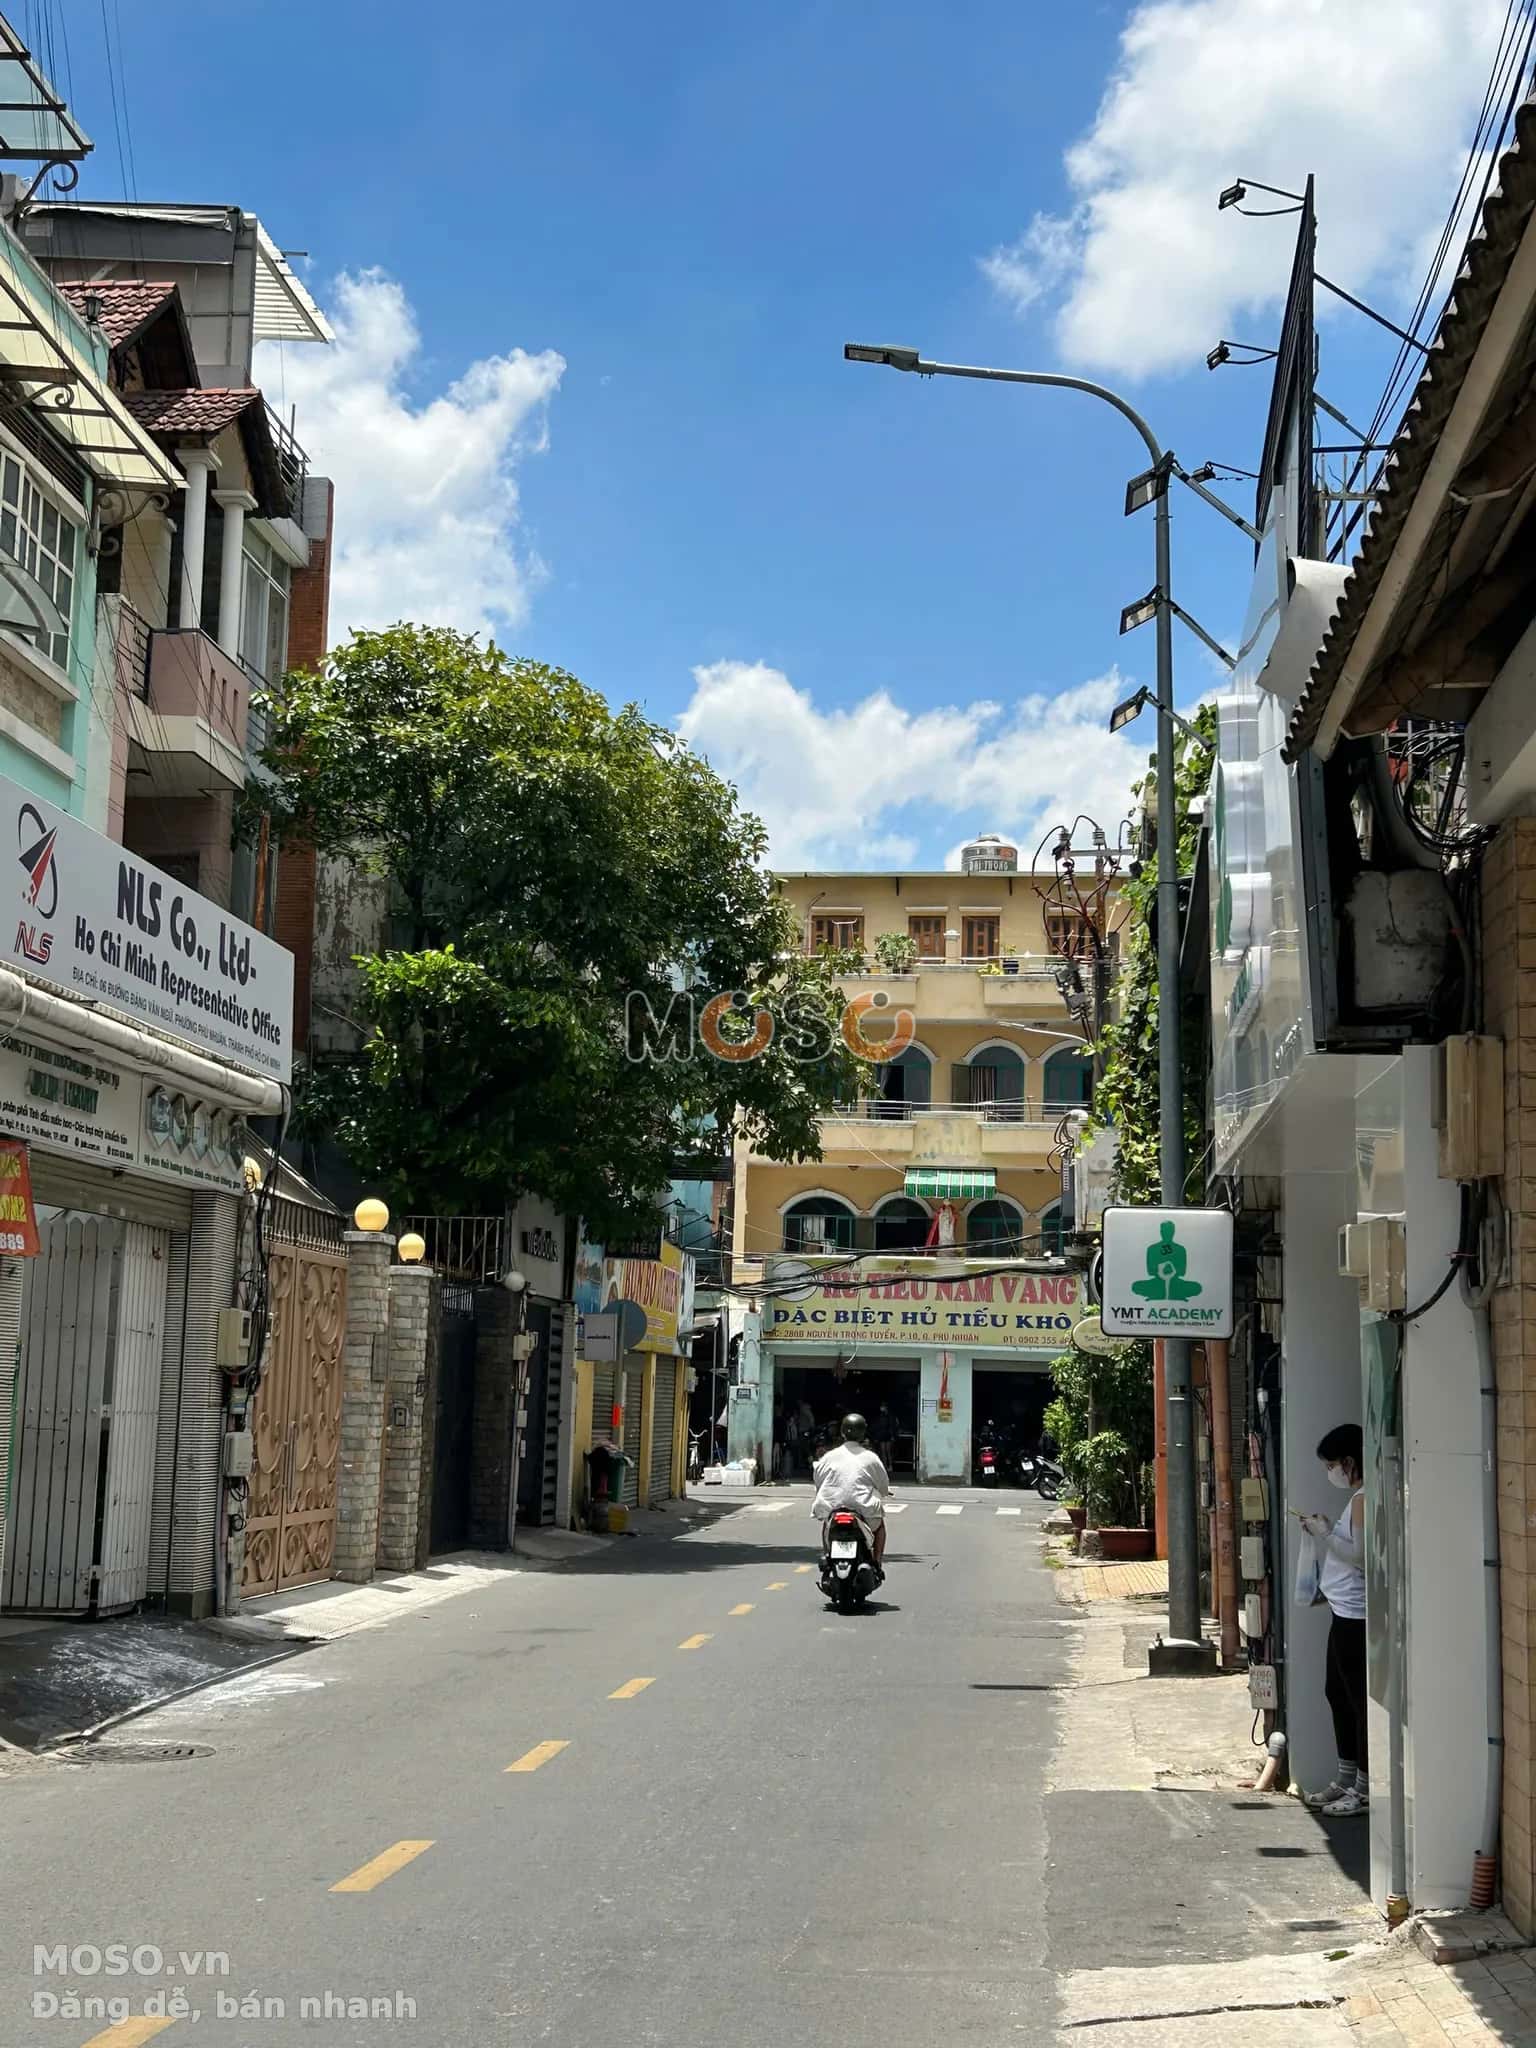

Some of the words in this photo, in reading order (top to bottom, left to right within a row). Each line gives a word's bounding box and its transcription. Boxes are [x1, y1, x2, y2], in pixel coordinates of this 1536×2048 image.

[117, 860, 162, 938] NLS
[13, 919, 54, 966] NLS
[74, 914, 95, 955] Ho
[100, 929, 121, 968] Chi
[124, 940, 157, 986] Minh
[160, 959, 249, 1030] Representative
[251, 1007, 281, 1046] Office
[935, 1273, 994, 1303] NAM
[1000, 1275, 1079, 1305] VANG
[774, 1306, 827, 1326] ĐẶC
[834, 1306, 893, 1327] BIỆT
[901, 1306, 937, 1326] HỦ
[946, 1307, 1008, 1328] TIẾU
[1015, 1312, 1072, 1329] KHÔ
[1111, 1306, 1145, 1320] YMT
[1146, 1307, 1224, 1321] ACADEMY
